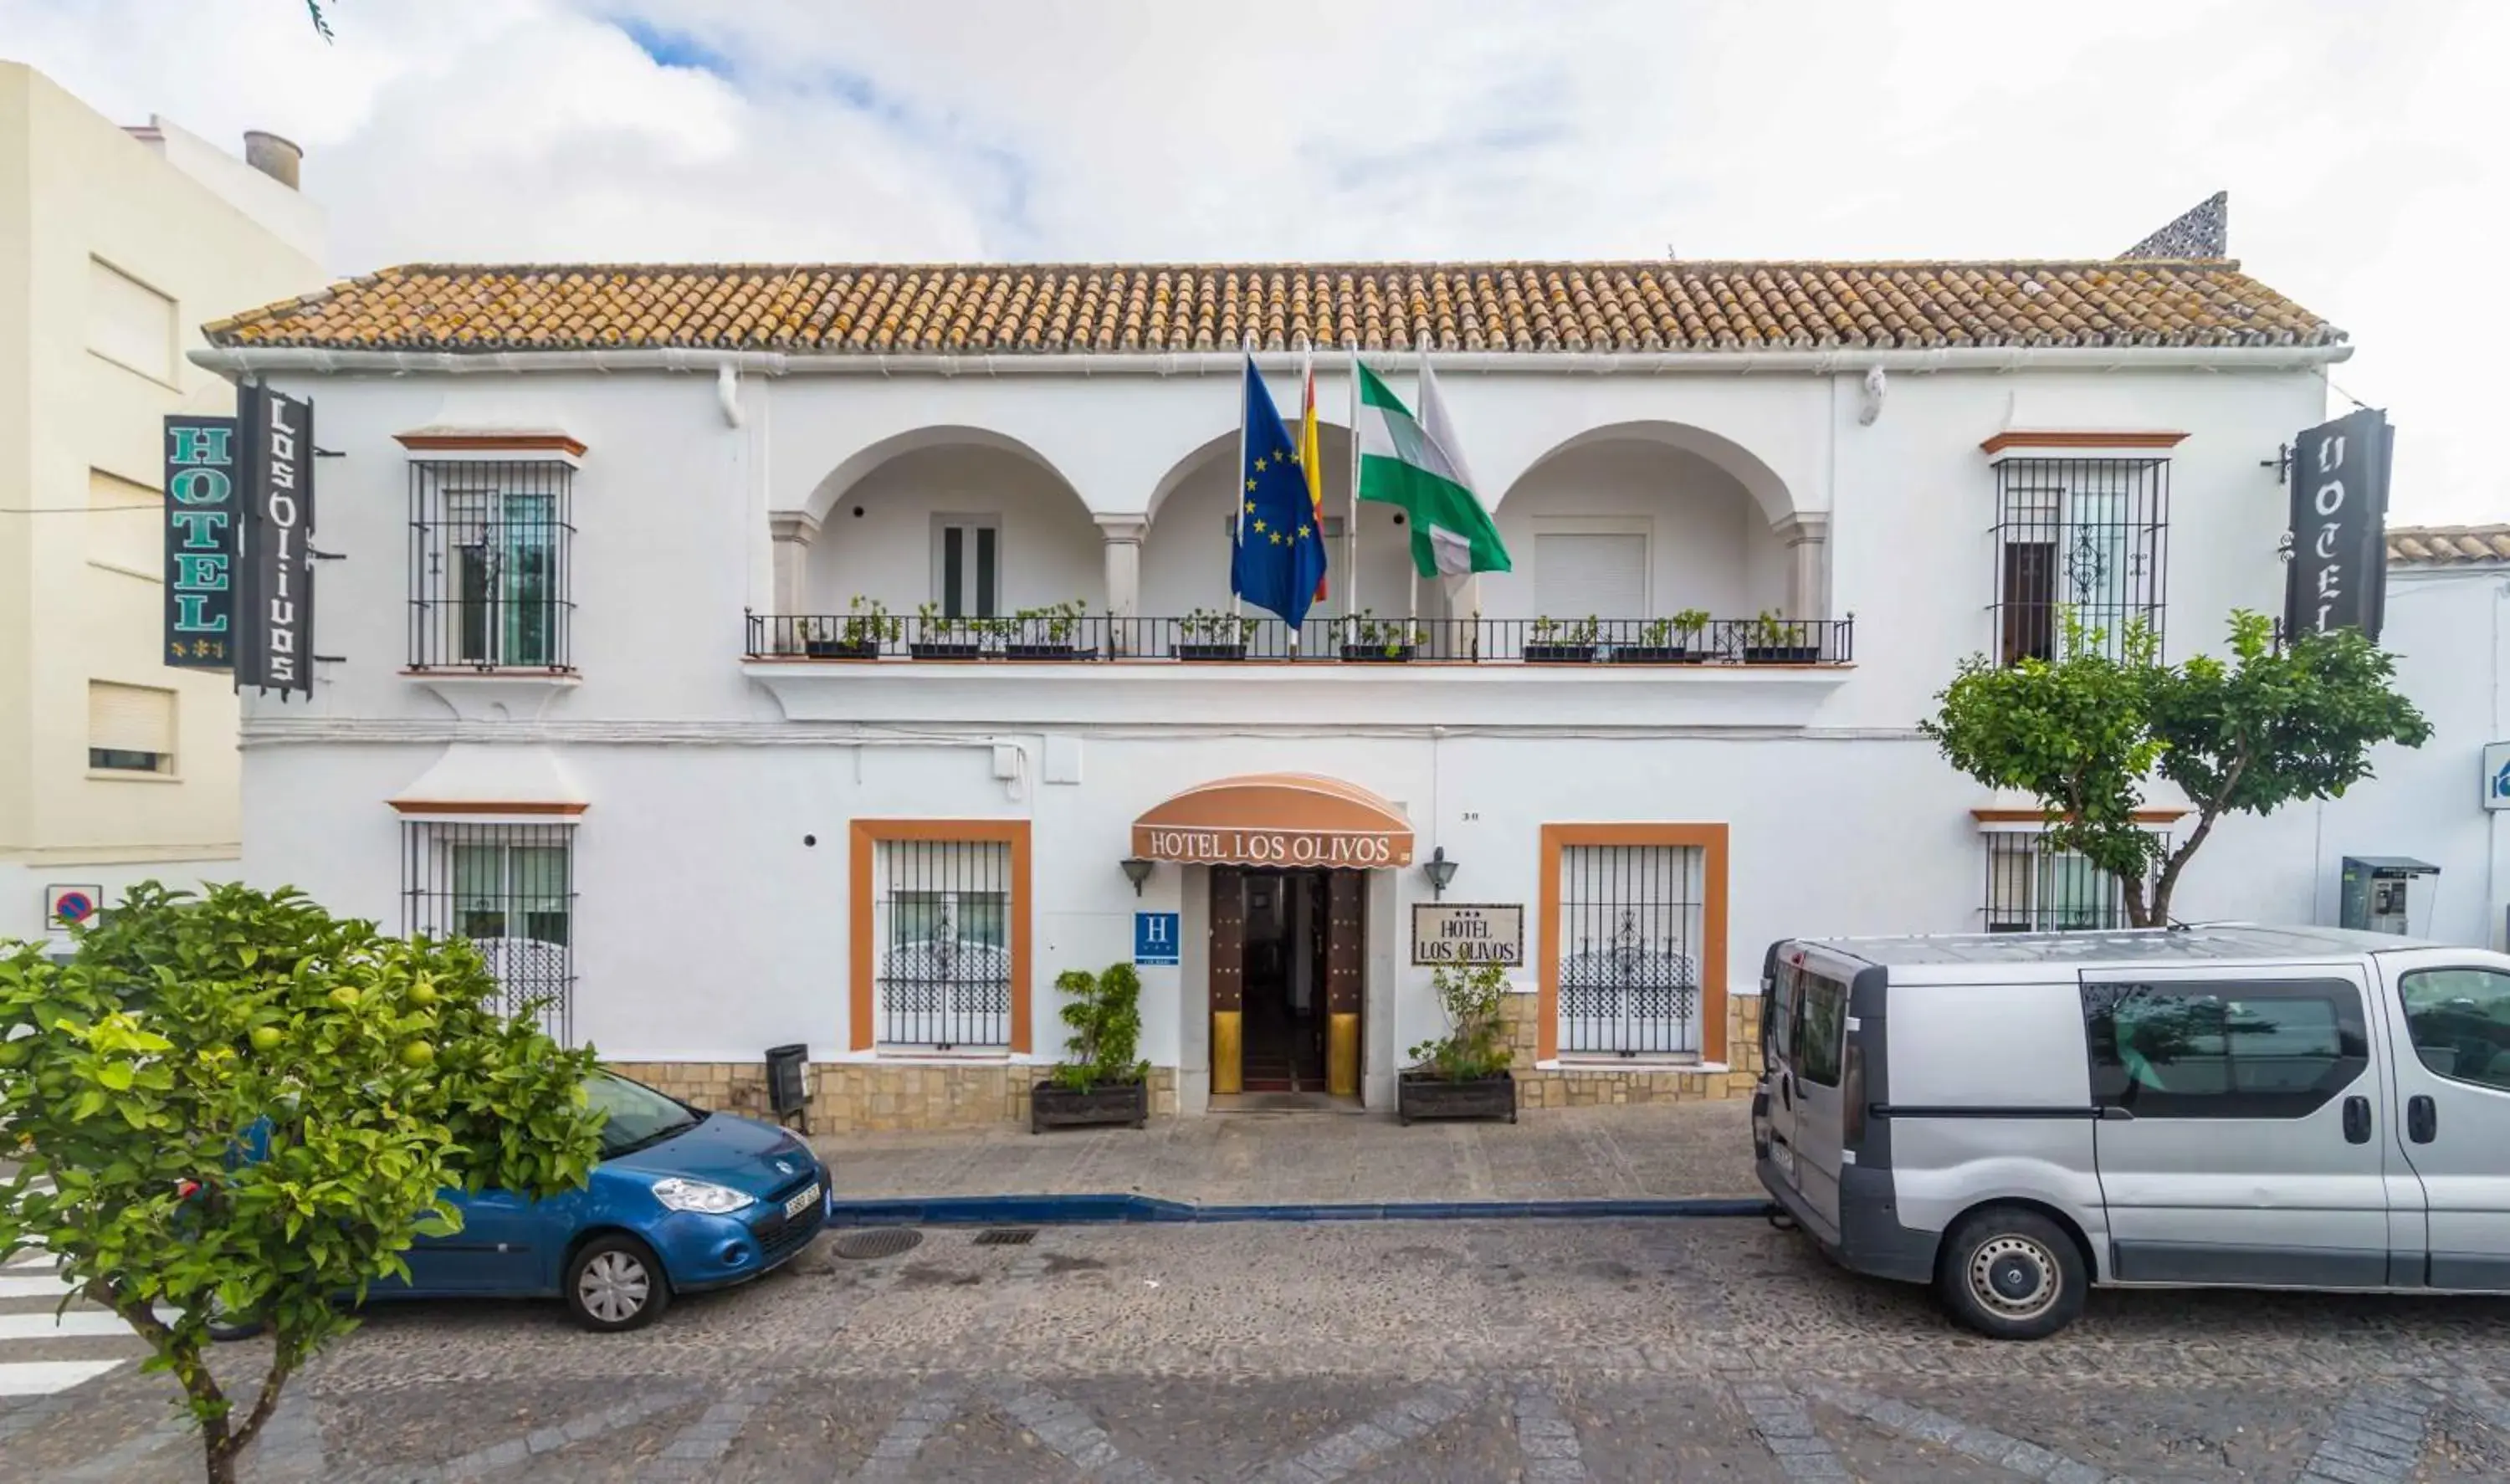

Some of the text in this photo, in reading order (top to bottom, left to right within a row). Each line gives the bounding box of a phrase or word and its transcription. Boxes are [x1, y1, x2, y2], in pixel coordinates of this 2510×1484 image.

[169, 427, 233, 632] HOTEL
[1151, 832, 1390, 862] HOTEL LOS OLIVOS
[1146, 917, 1168, 942] H
[1442, 920, 1493, 939] HOTEL
[1421, 941, 1514, 960] LOS OLIVOS
